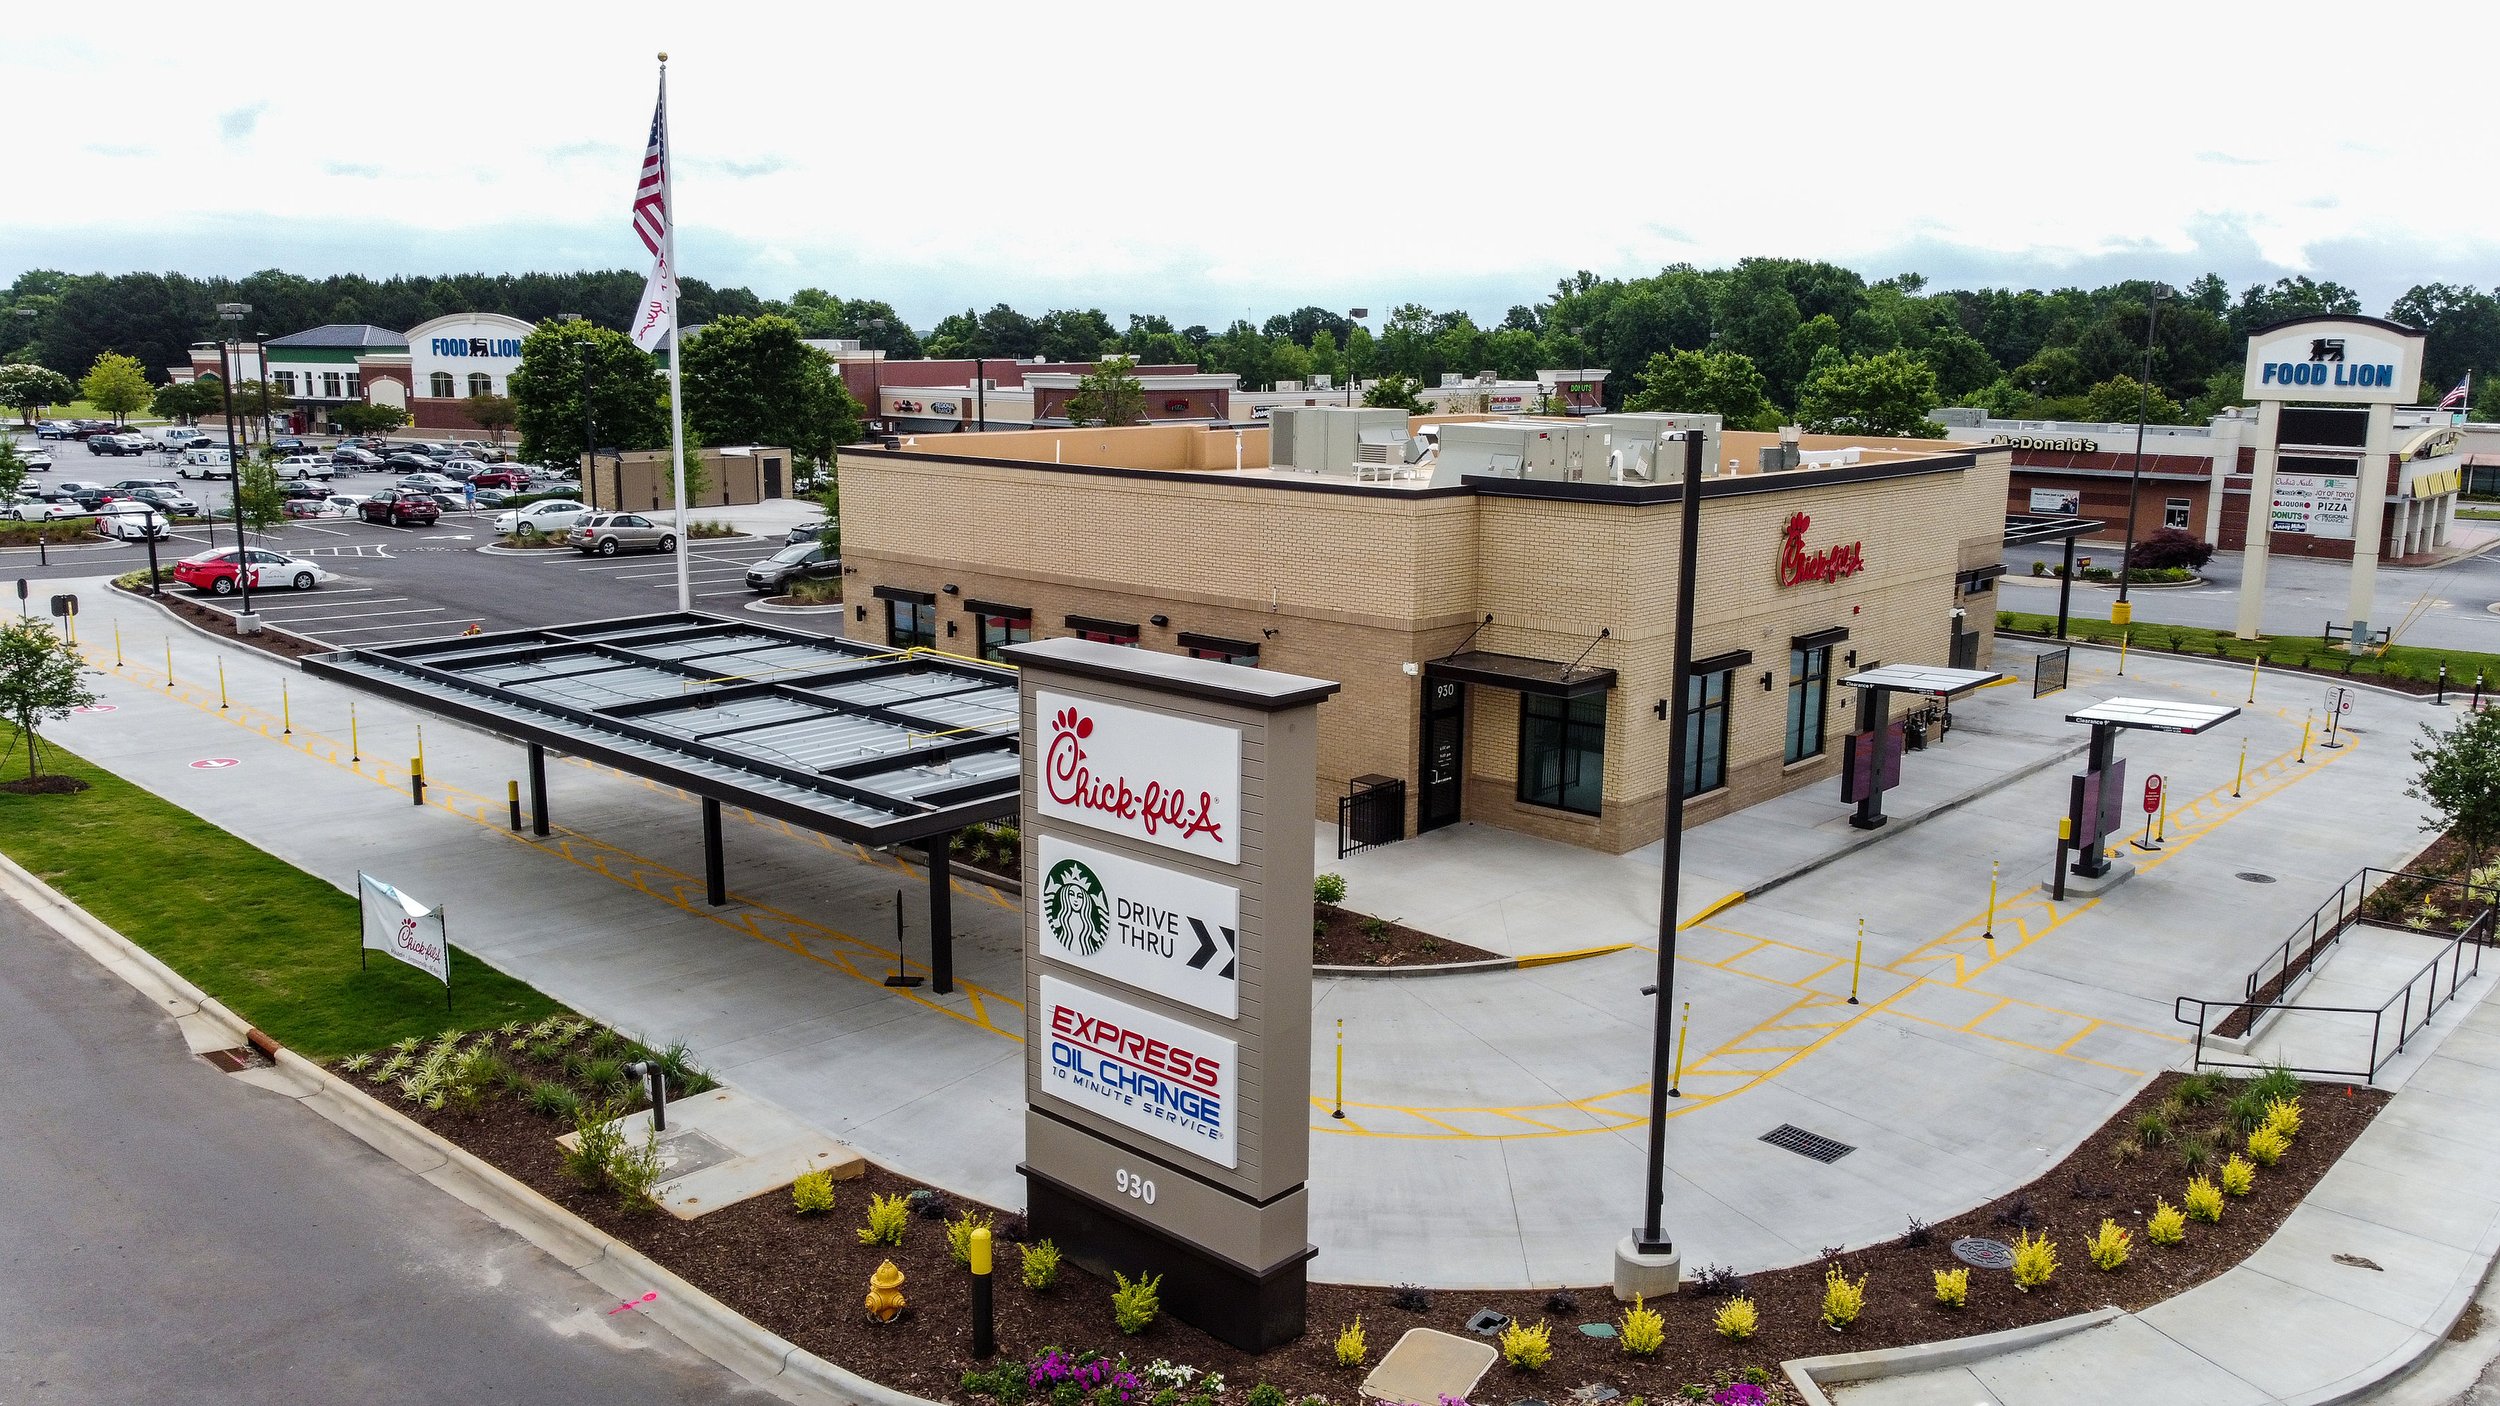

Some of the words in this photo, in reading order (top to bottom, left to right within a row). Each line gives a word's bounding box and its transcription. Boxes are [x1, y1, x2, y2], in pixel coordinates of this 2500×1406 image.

[432, 338, 468, 357] FOOD
[489, 338, 522, 358] LION
[2262, 362, 2327, 385] FOOD
[2334, 363, 2393, 387] LION
[1993, 435, 2096, 452] McDonald's
[2279, 500, 2304, 508] LIQUOR
[2317, 502, 2348, 512] PIZZA
[2336, 491, 2355, 499] TOKYO
[2271, 511, 2303, 520] DONUTS
[1437, 684, 1454, 698] 930
[2075, 717, 2103, 725] Clearance
[1046, 728, 1223, 843] Chick-fil-A
[1117, 897, 1179, 936] DRIVE
[398, 924, 441, 964] Chick-fil-A
[1117, 922, 1174, 959] THRU
[1052, 1004, 1220, 1087] EXPRESS
[1052, 1041, 1094, 1078] OIL
[1100, 1060, 1220, 1127] CHANGE
[1052, 1066, 1066, 1079] 10
[1073, 1075, 1133, 1106] MINUTE
[1143, 1102, 1219, 1140] SERVICE
[1116, 1169, 1156, 1205] 930
